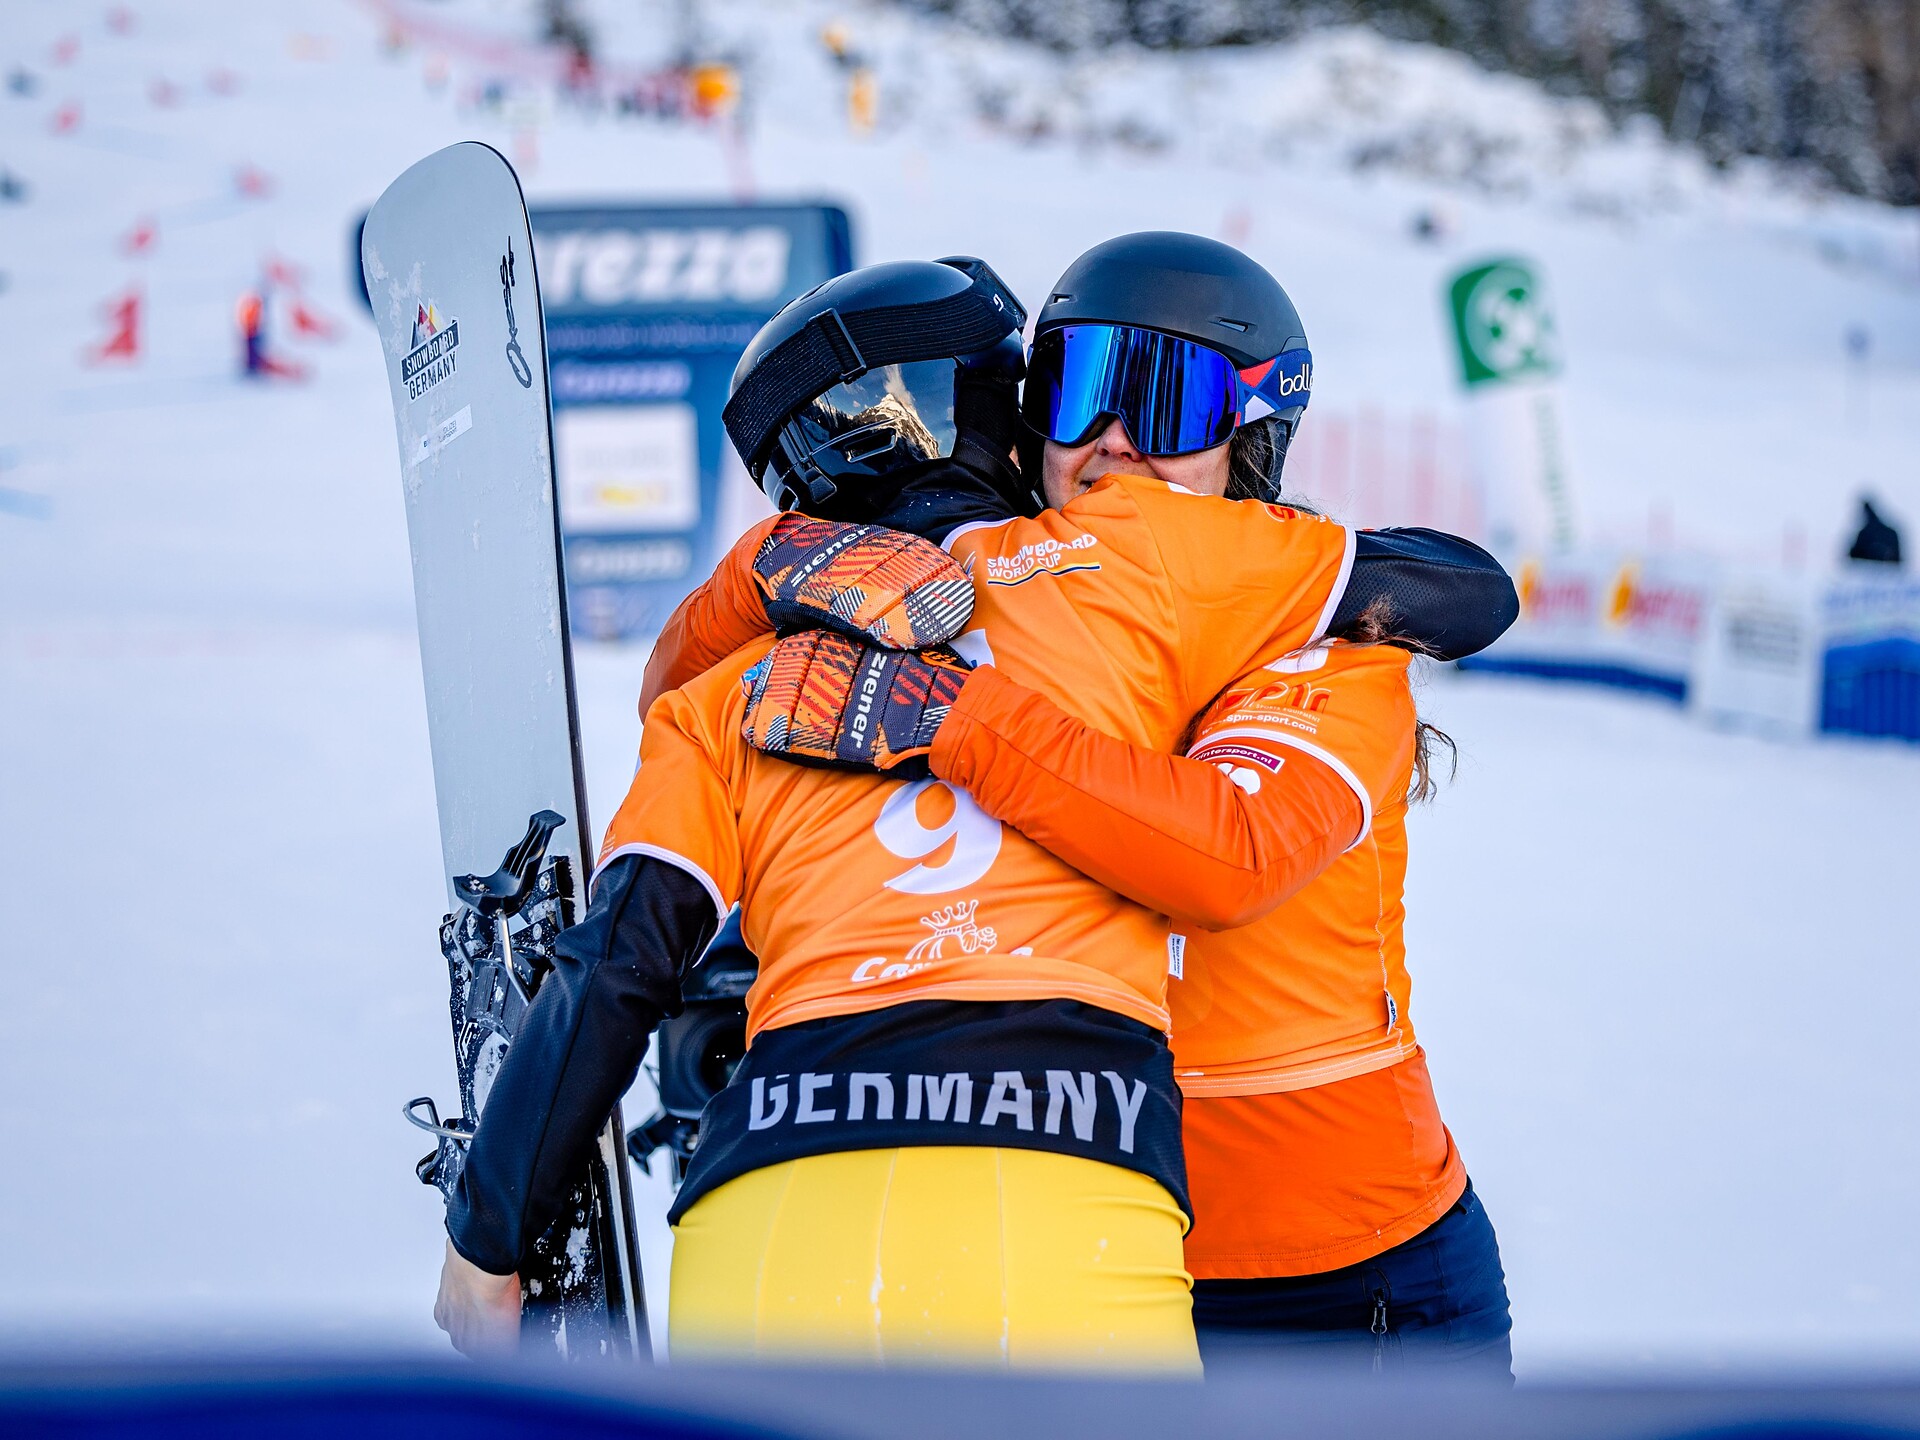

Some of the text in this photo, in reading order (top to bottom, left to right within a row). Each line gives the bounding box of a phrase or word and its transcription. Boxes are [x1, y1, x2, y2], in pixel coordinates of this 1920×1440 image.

[541, 229, 791, 304] rezza
[409, 350, 456, 400] GERMANY
[790, 526, 870, 588] ziener
[987, 534, 1097, 568] SNOWBOARD
[988, 557, 1034, 579] WORLD
[1037, 553, 1061, 568] CUP
[851, 652, 887, 748] ziener
[874, 780, 1002, 894] 9
[748, 1069, 1148, 1154] GERMANY
